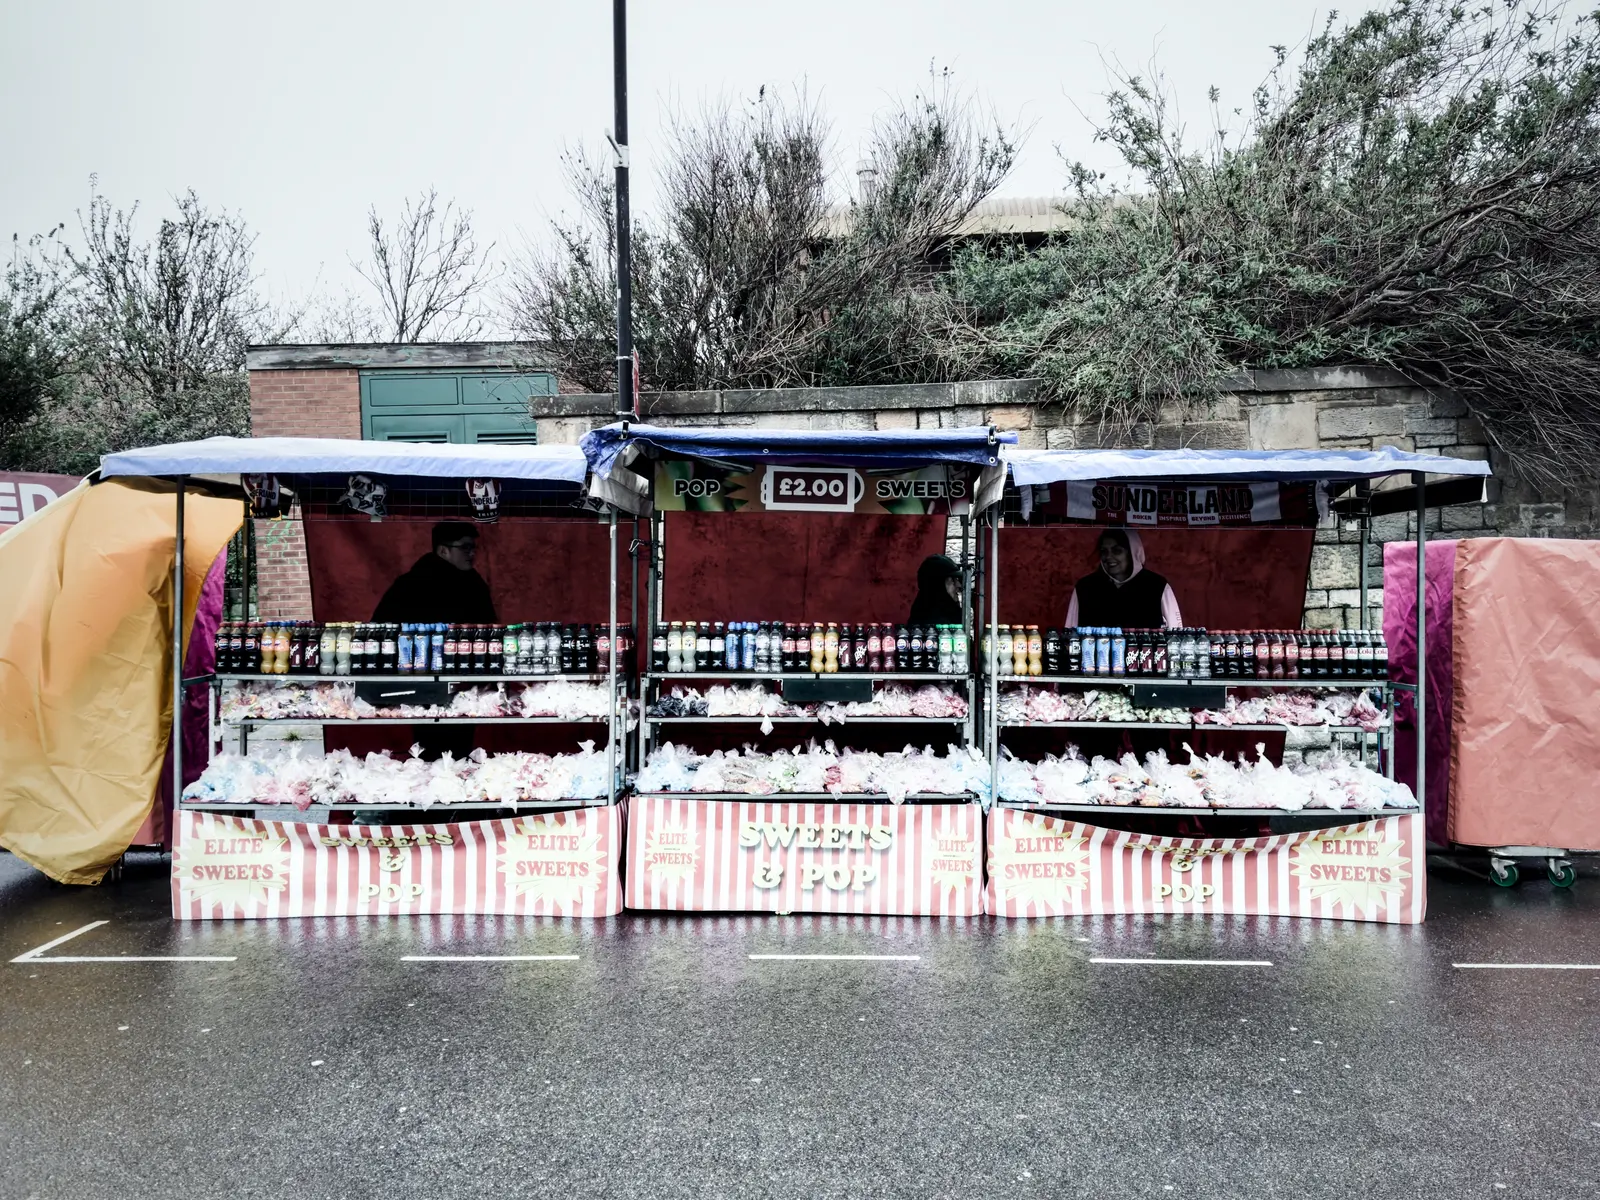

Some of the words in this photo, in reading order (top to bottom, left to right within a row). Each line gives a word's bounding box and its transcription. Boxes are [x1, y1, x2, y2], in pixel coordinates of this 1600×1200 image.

[674, 479, 721, 497] POP
[779, 478, 844, 497] £2.00
[876, 480, 966, 498] SWEETS
[1092, 485, 1254, 514] SUNDERLAND
[527, 834, 579, 851] ELITE
[659, 832, 688, 845] ELITE
[739, 822, 892, 851] SWEETS
[938, 839, 967, 852] ELITE
[1015, 837, 1065, 853] ELITE
[204, 838, 263, 855] ELITE
[1321, 840, 1379, 856] ELITE
[379, 853, 405, 872] &
[652, 852, 693, 865] SWEETS
[931, 859, 974, 872] SWEETS
[192, 864, 274, 880] SWEETS
[516, 860, 589, 877] SWEETS
[752, 862, 784, 889] &
[800, 863, 876, 891] POP
[1005, 862, 1076, 880] SWEETS
[1310, 864, 1391, 882] SWEETS
[361, 883, 423, 903] POP
[1155, 883, 1215, 903] POP
